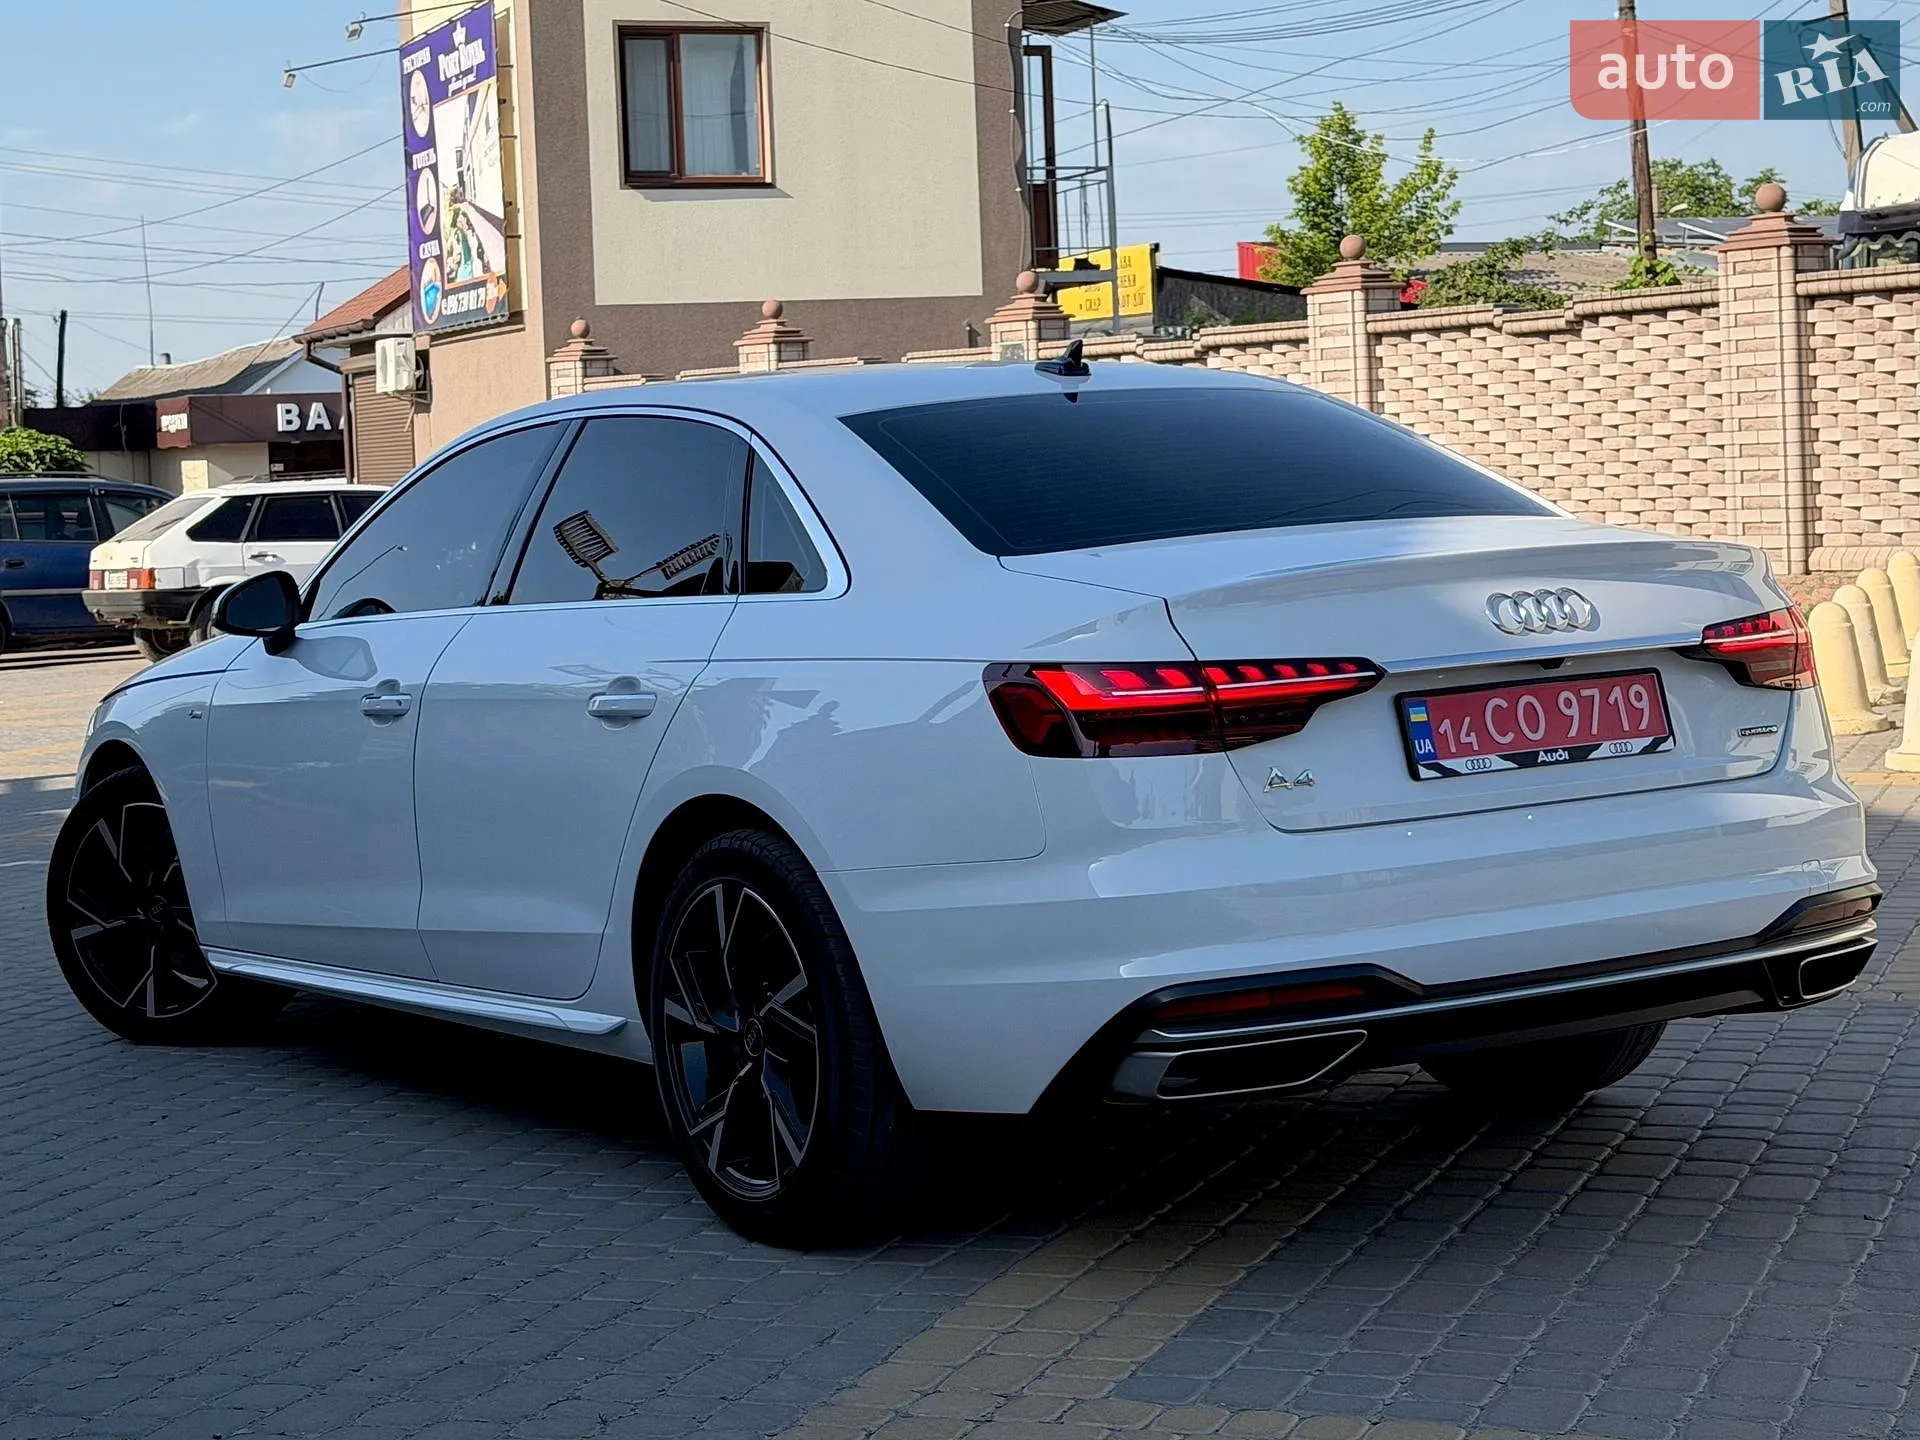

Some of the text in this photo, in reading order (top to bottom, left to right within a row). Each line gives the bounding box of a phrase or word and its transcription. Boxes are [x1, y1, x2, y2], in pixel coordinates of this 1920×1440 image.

[1437, 683, 1650, 753] 14 CO 9719
[1414, 738, 1434, 755] UA
[1537, 748, 1569, 764] Audi
[1263, 767, 1316, 793] A4
